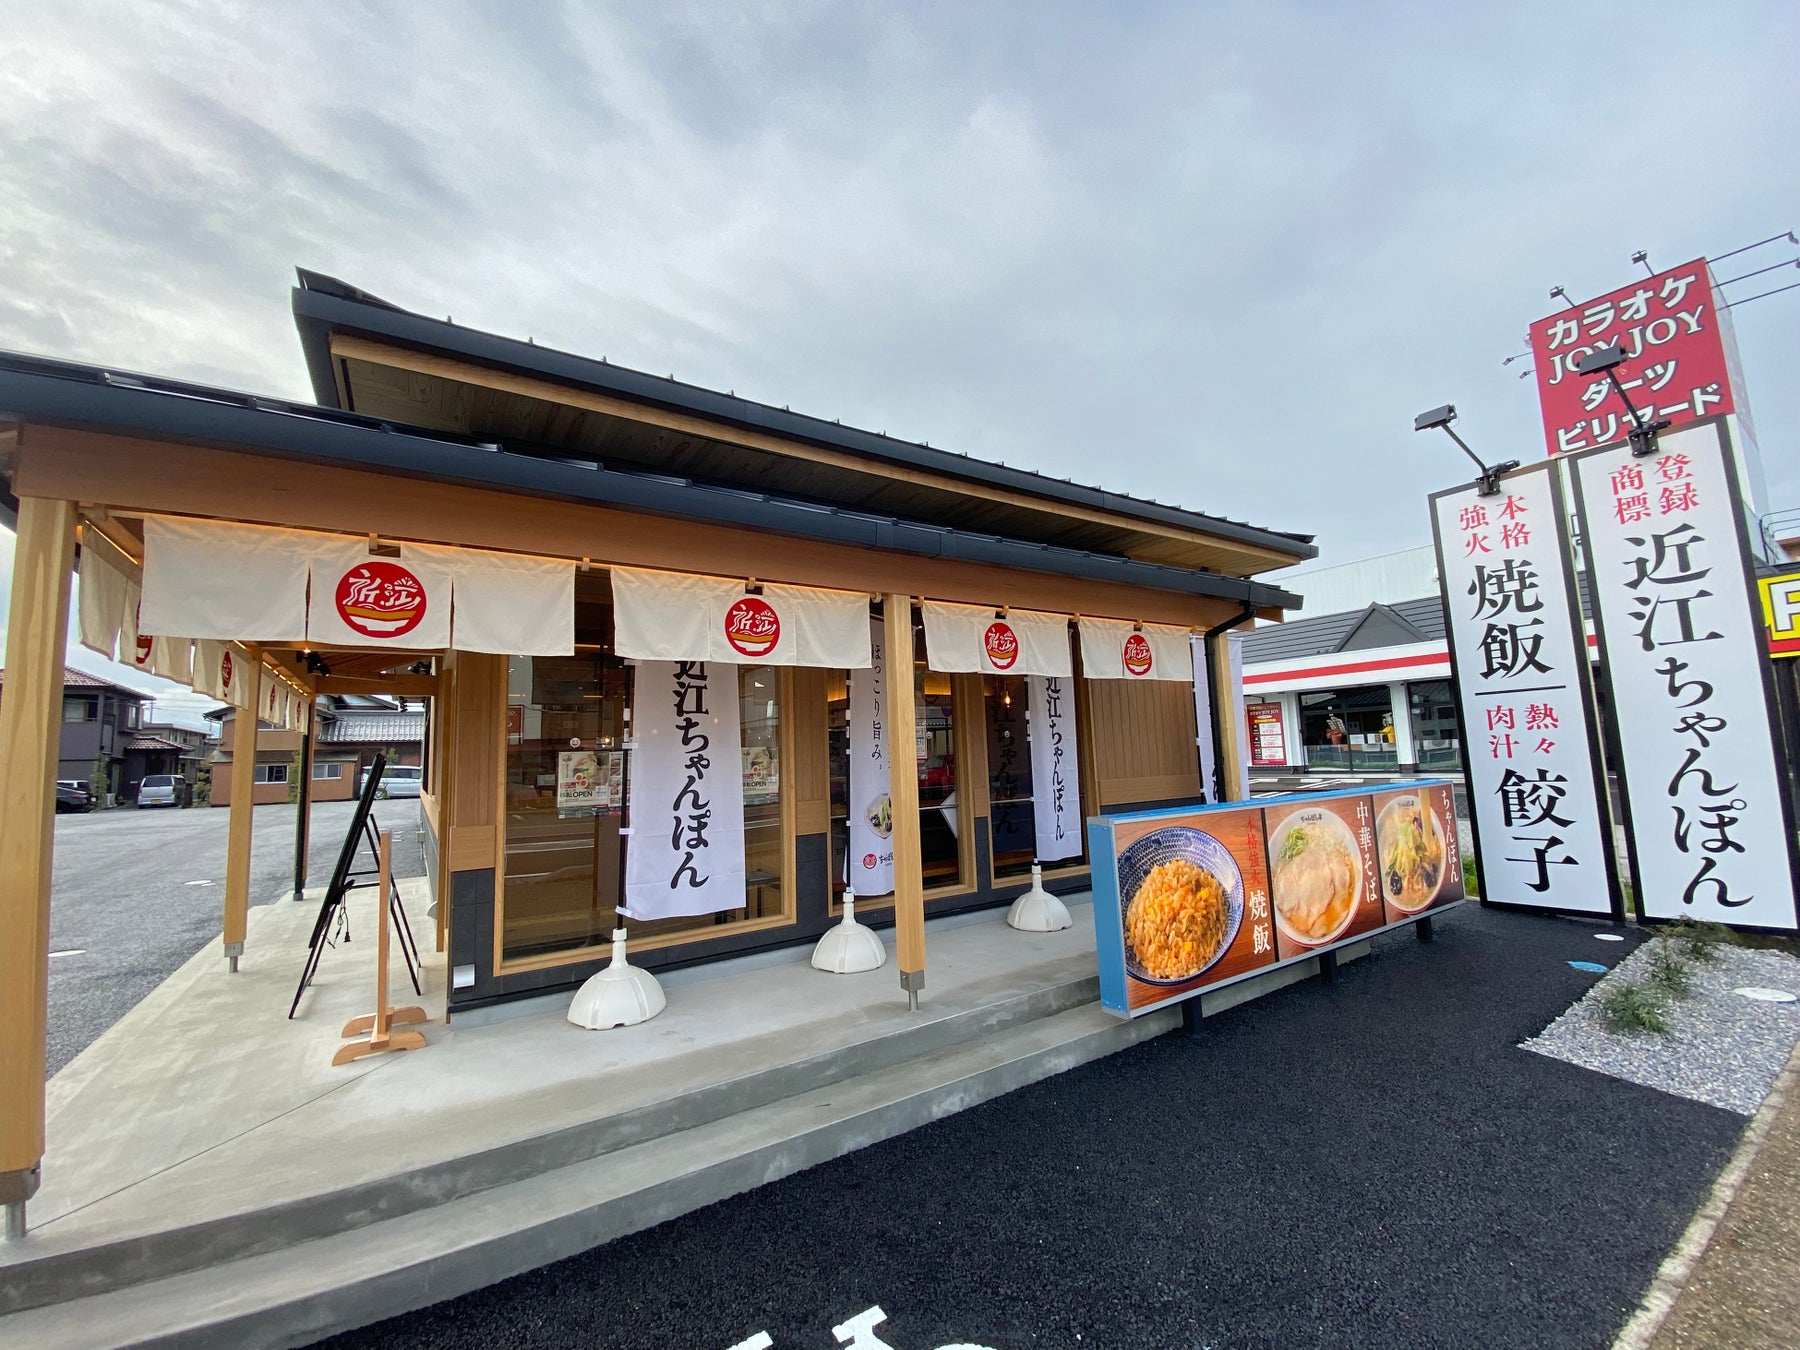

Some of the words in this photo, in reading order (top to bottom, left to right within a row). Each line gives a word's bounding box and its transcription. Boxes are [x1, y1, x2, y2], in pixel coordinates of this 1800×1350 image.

[1547, 275, 1696, 350] カラオケ
[1628, 304, 1704, 358] JOY
[1580, 360, 1677, 412] ダーツ
[1609, 463, 1652, 526] 商標
[1655, 453, 1700, 516] 登録
[1458, 506, 1492, 559] 強火
[1497, 494, 1531, 549] 本格
[1466, 558, 1555, 680] 焼飯
[1486, 704, 1520, 760] 肉汁
[1524, 703, 1560, 756] 熱々
[1621, 522, 1756, 908] 近江ちゃんぽん
[1246, 815, 1262, 886] 本格強火
[1356, 801, 1378, 903] 中華そば
[1441, 789, 1460, 883] ちゃんぽん
[1494, 767, 1579, 894] 餃子
[1248, 889, 1272, 955] 焼飯
